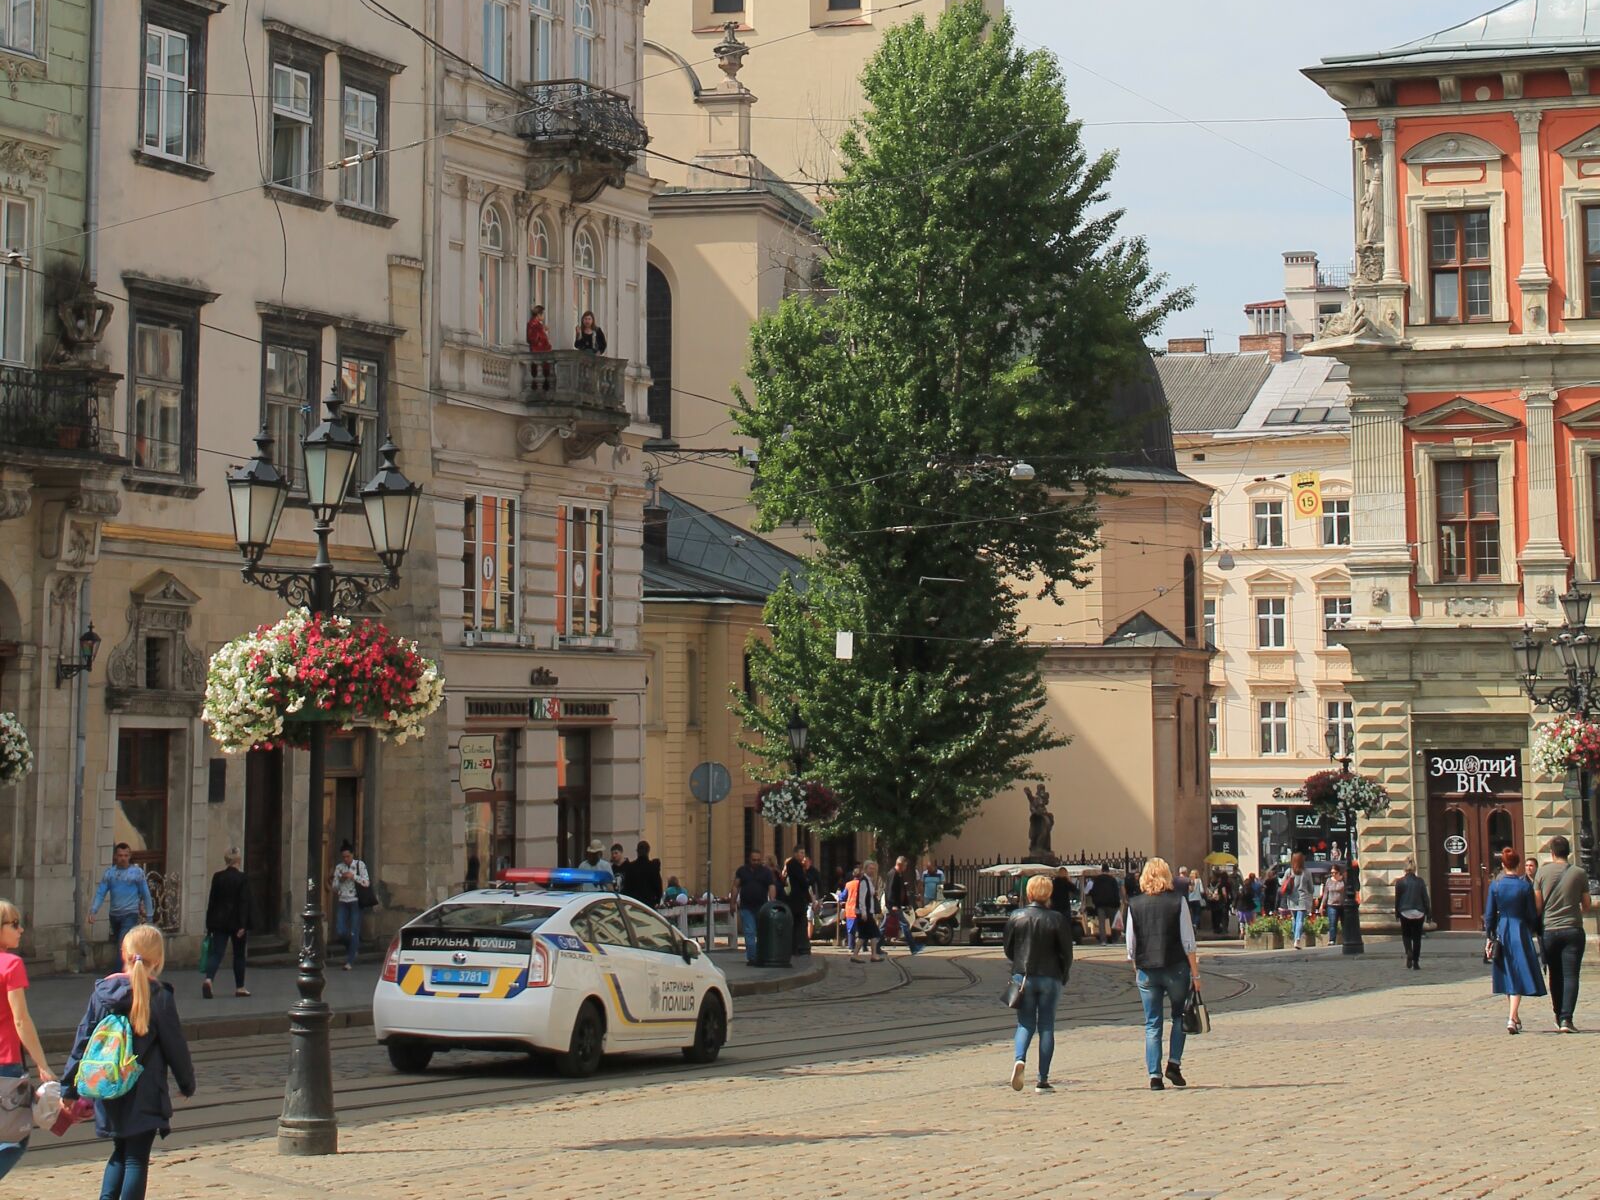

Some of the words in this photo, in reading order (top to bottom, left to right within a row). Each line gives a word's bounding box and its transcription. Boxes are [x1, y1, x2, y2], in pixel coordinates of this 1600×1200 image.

[1301, 496, 1315, 508] 15
[1457, 773, 1492, 793] ВІК
[1296, 814, 1320, 825] EA7
[411, 937, 470, 948] ПАТРУЛЬНА
[472, 938, 517, 950] ПОЛІЦІЯ
[565, 938, 580, 949] 102
[459, 970, 482, 983] 3781
[662, 981, 695, 992] ПАТРУЛЬНА
[662, 995, 695, 1012] ПОЛІЦІЯ
